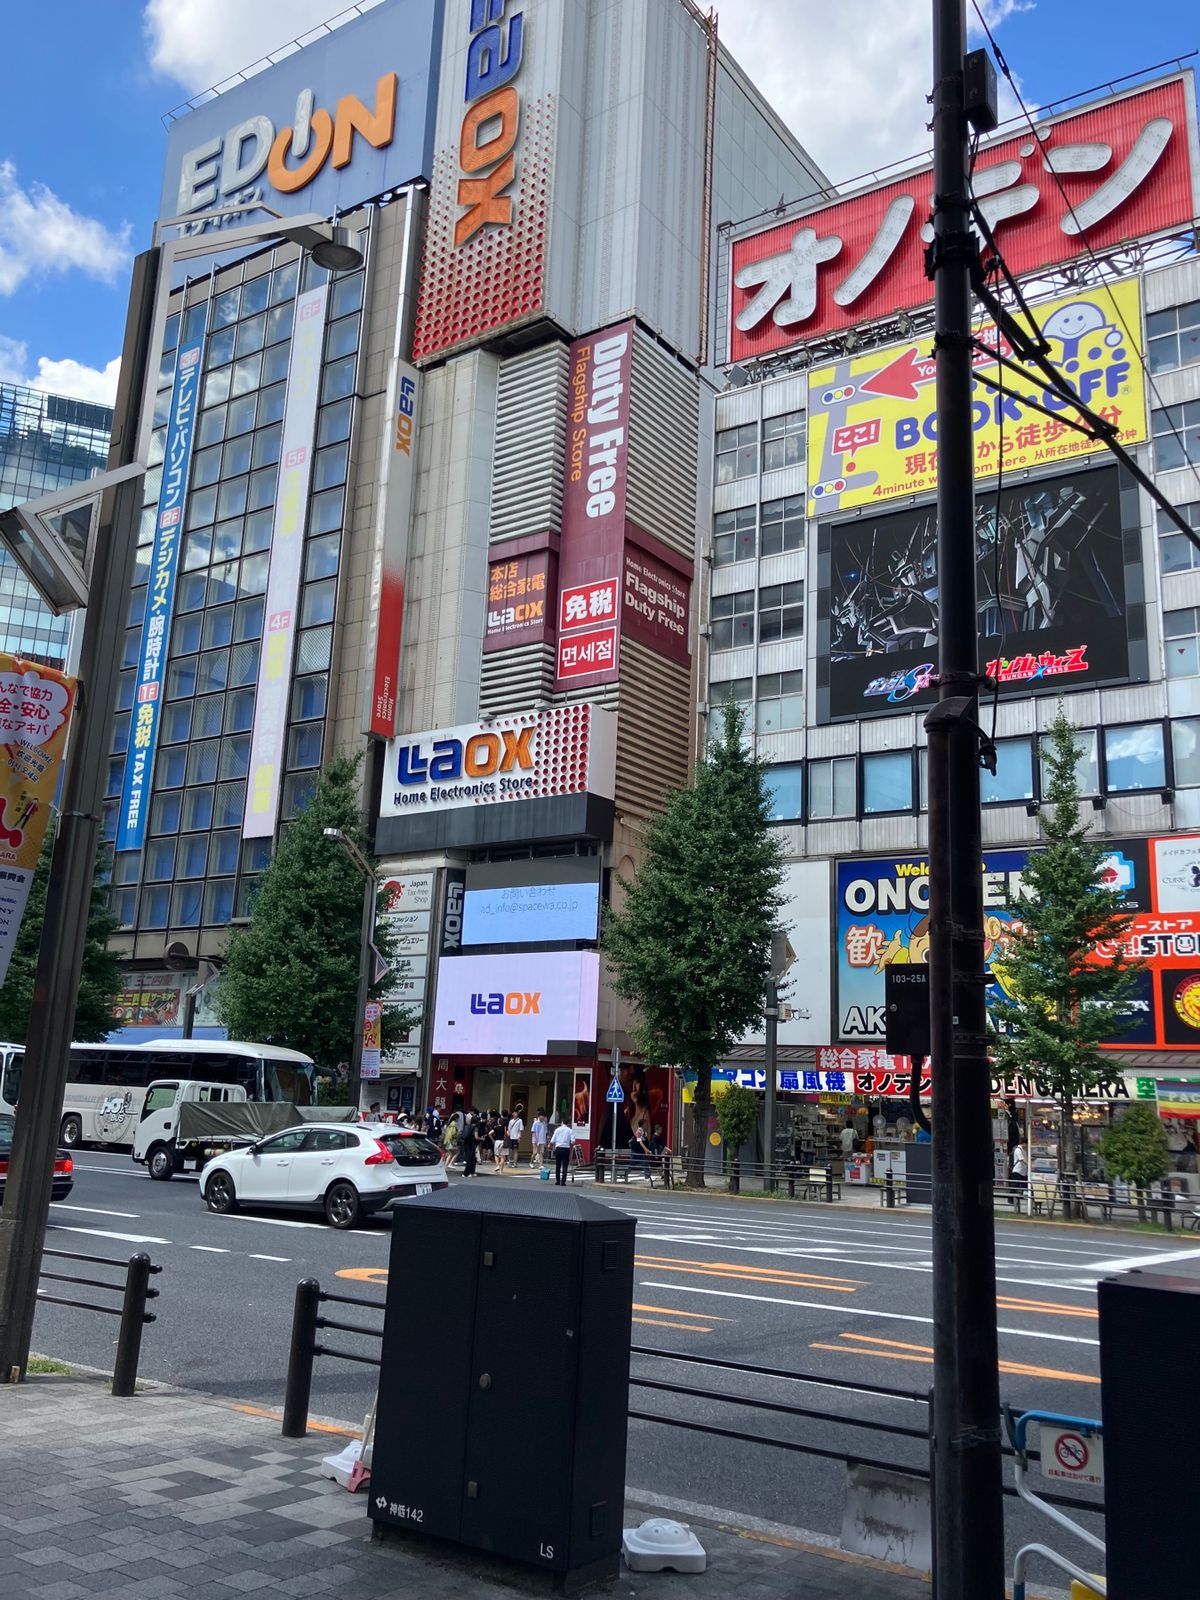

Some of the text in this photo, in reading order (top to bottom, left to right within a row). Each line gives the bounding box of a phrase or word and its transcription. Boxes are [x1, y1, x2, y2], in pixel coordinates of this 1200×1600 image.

[177, 72, 398, 214] EDION
[735, 117, 1174, 332] オノデン
[570, 346, 591, 481] Flagship Store
[586, 332, 628, 518] Duty Free
[165, 367, 195, 508] テレビ・パソコン
[490, 572, 545, 602] 総合家電
[491, 562, 518, 582] 本店
[565, 587, 613, 622] 免税
[625, 570, 685, 619] Flagship
[270, 616, 290, 630] 4F
[625, 590, 685, 635] Duty Free
[562, 638, 612, 668] 면세점
[141, 685, 158, 700] 1F
[135, 704, 154, 749] 免税
[127, 751, 146, 831] TAX FREE
[394, 776, 533, 805] Home Electronics Store
[891, 974, 927, 984] 103-25A
[780, 1070, 846, 1093] 扇風機
[539, 1542, 554, 1559] LS
